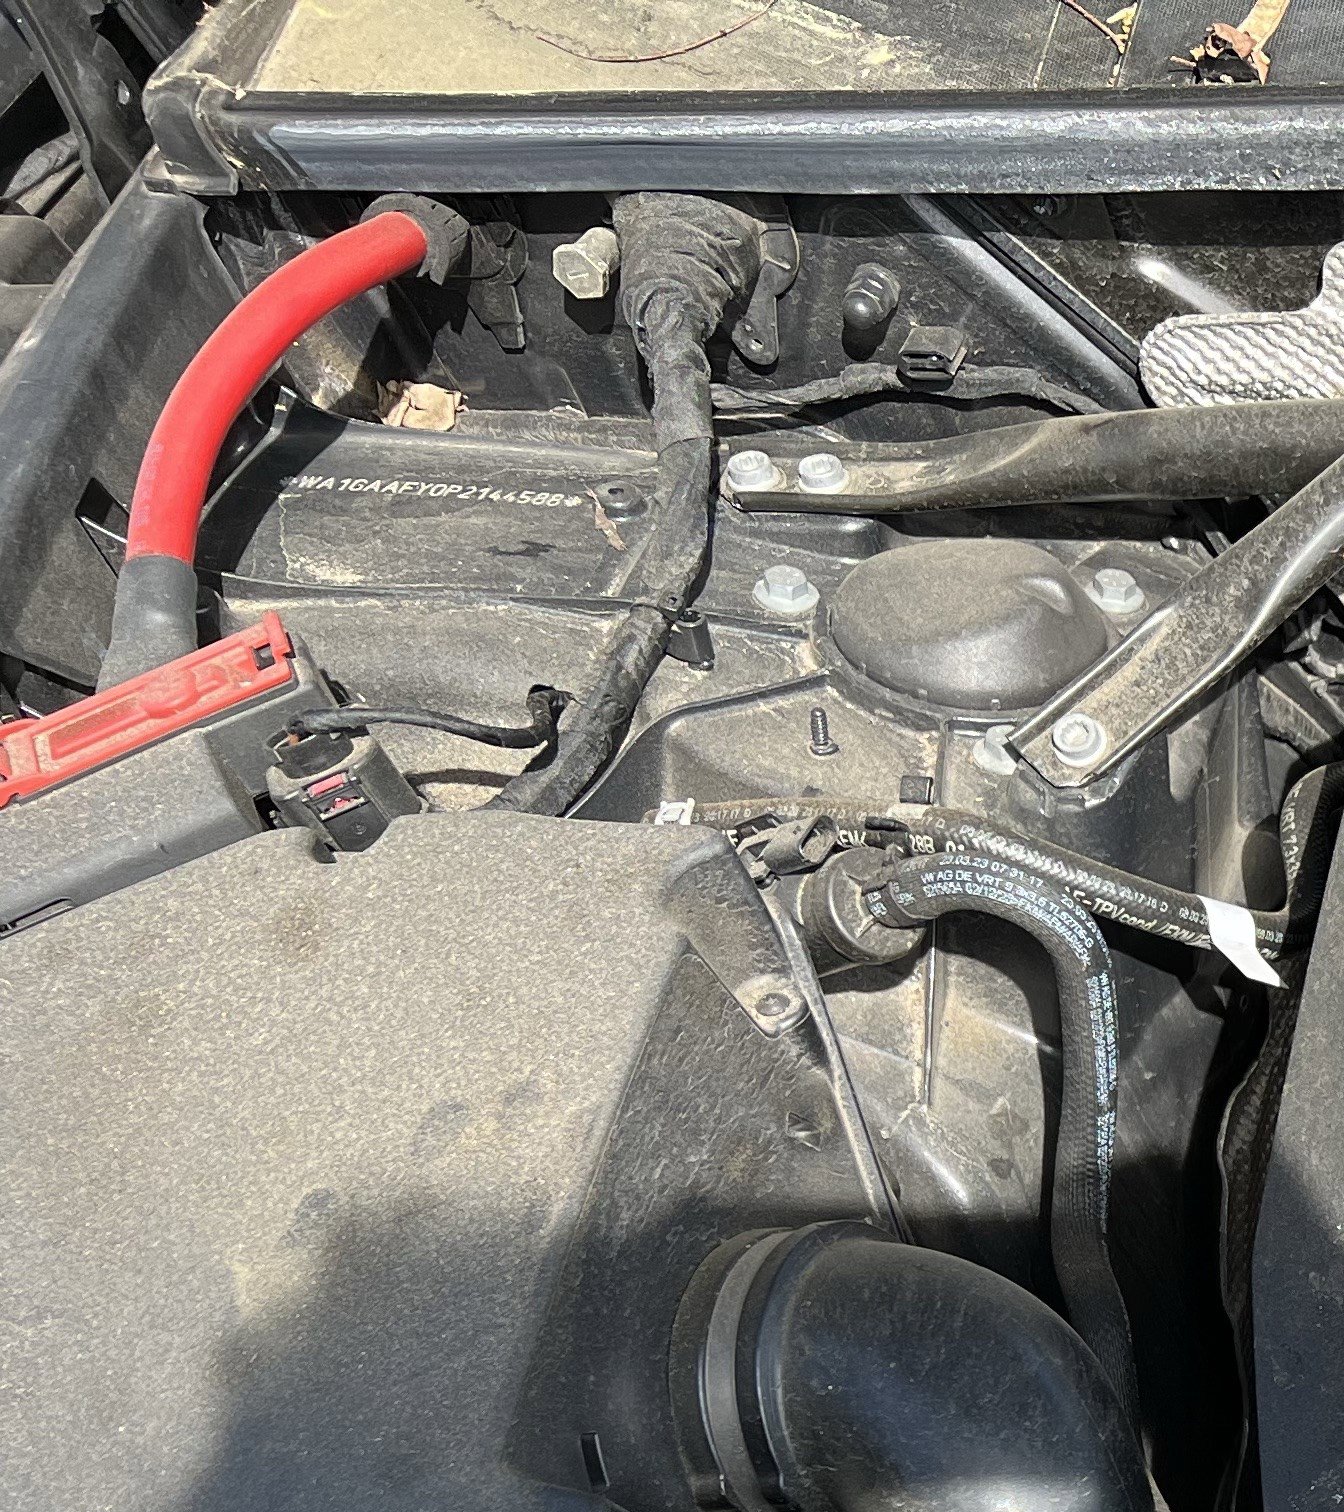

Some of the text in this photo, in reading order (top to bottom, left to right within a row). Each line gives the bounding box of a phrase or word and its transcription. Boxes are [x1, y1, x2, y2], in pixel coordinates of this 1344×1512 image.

[937, 870, 953, 882] AG
[955, 870, 972, 882] DE
[975, 872, 1001, 888] VRT
